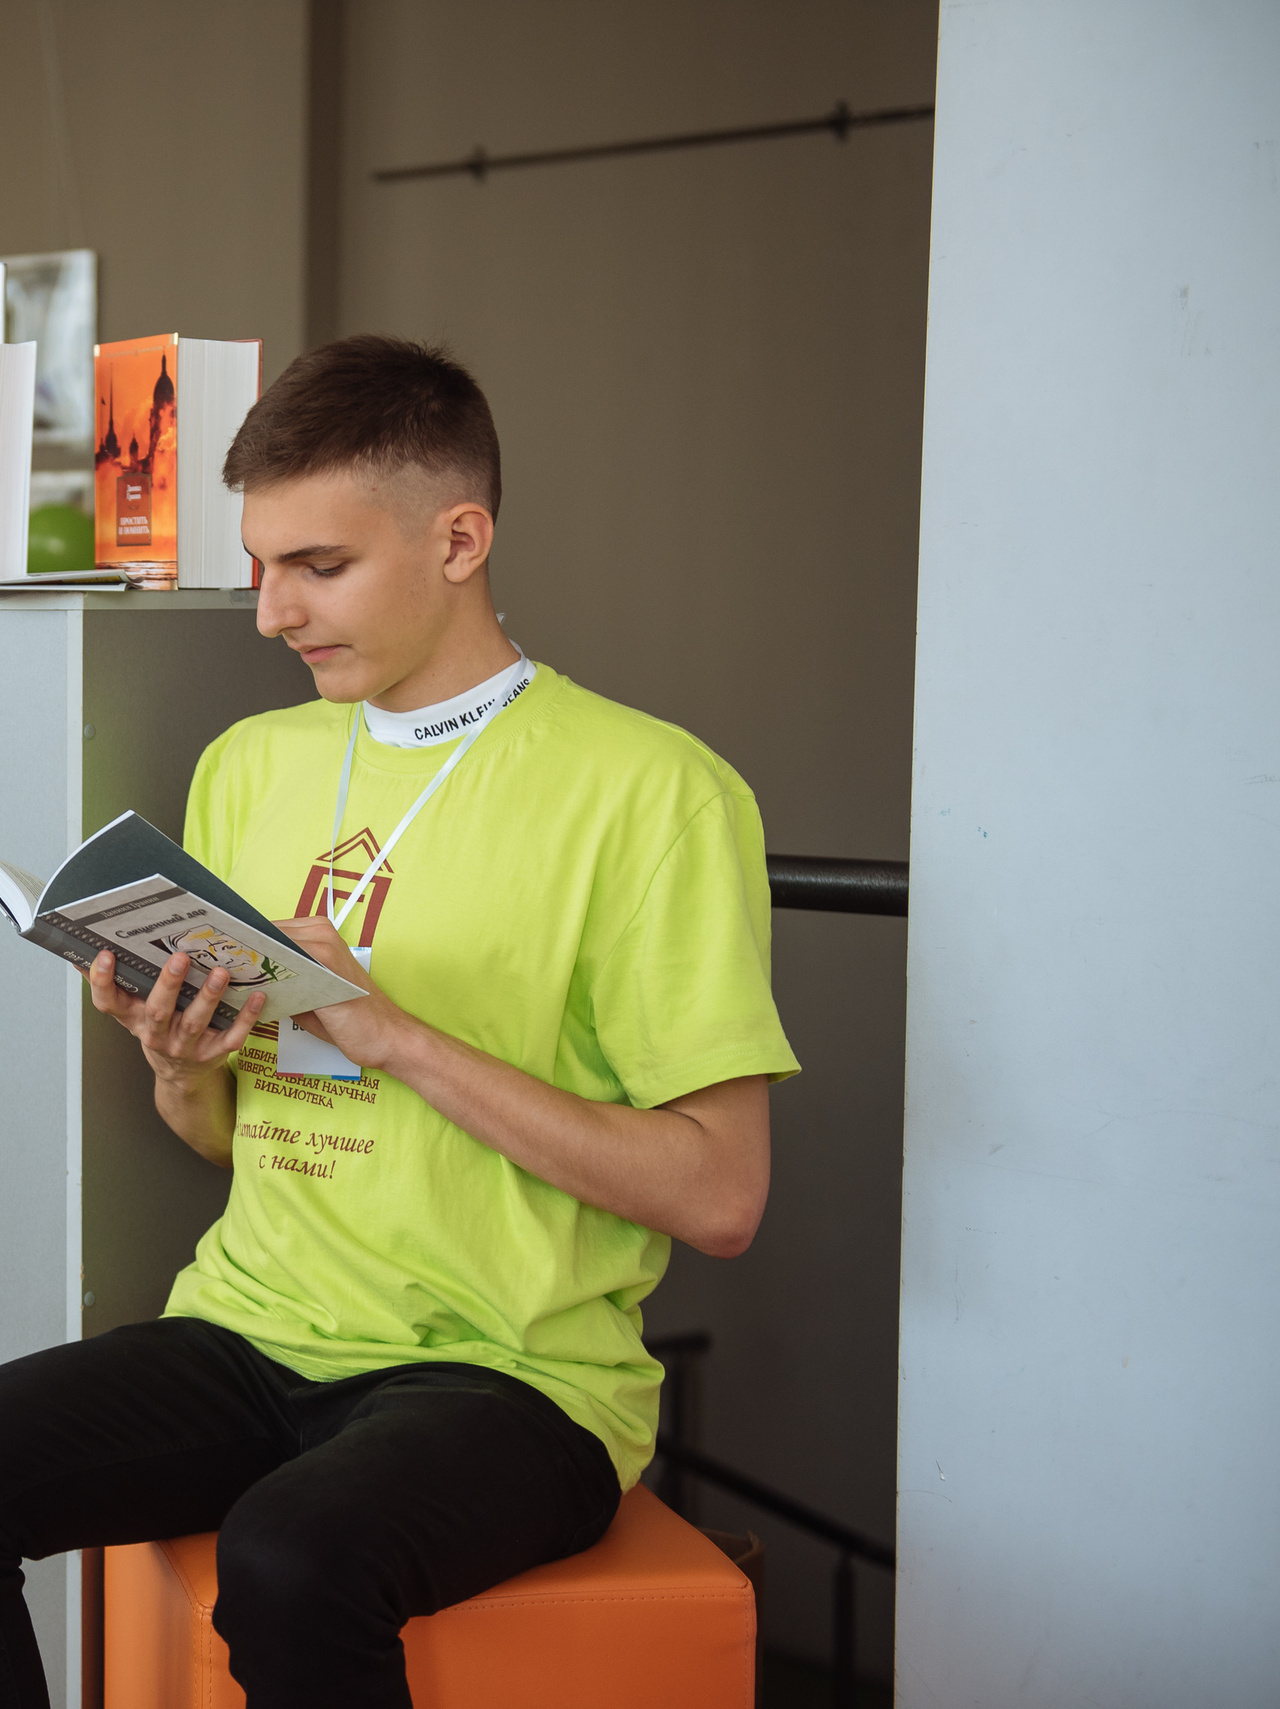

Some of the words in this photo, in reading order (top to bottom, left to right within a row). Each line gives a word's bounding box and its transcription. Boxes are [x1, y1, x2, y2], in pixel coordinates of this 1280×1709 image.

[414, 717, 459, 740] CALVIN
[459, 698, 496, 727] KLEI
[101, 903, 132, 918] Даниил
[130, 896, 160, 909] Гранин
[115, 914, 185, 939] Священный
[186, 908, 208, 920] дар
[254, 1078, 334, 1109] БИБЛИОТЕКА
[321, 1081, 377, 1105] НАУЧНАЯ
[305, 1132, 375, 1155] лучшее
[271, 1155, 336, 1180] нами!
